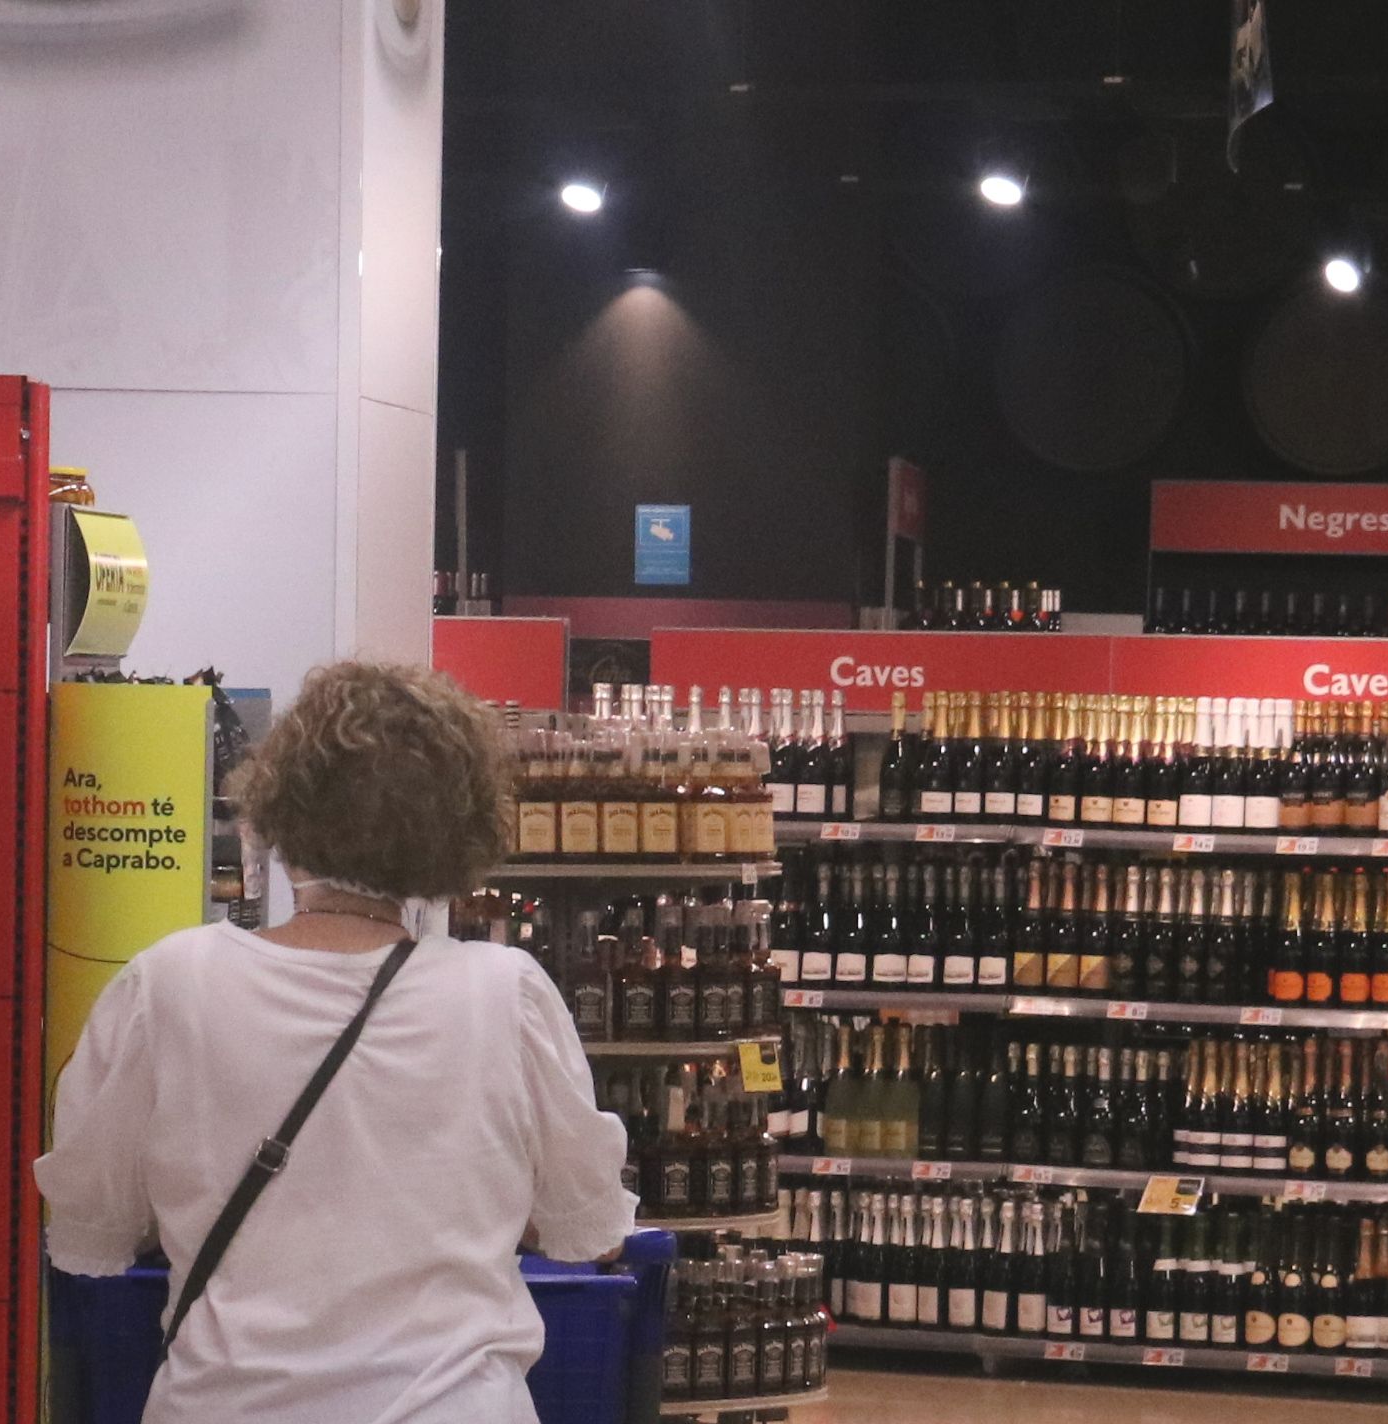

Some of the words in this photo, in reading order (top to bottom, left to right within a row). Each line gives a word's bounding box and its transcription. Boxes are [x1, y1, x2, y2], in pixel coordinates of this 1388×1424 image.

[830, 656, 925, 688] Caves
[63, 767, 102, 791] Ara,
[63, 794, 145, 817] tothom
[151, 795, 174, 816] té
[63, 822, 186, 849] descompte
[62, 851, 73, 867] a
[76, 848, 181, 873] Caprabo.
